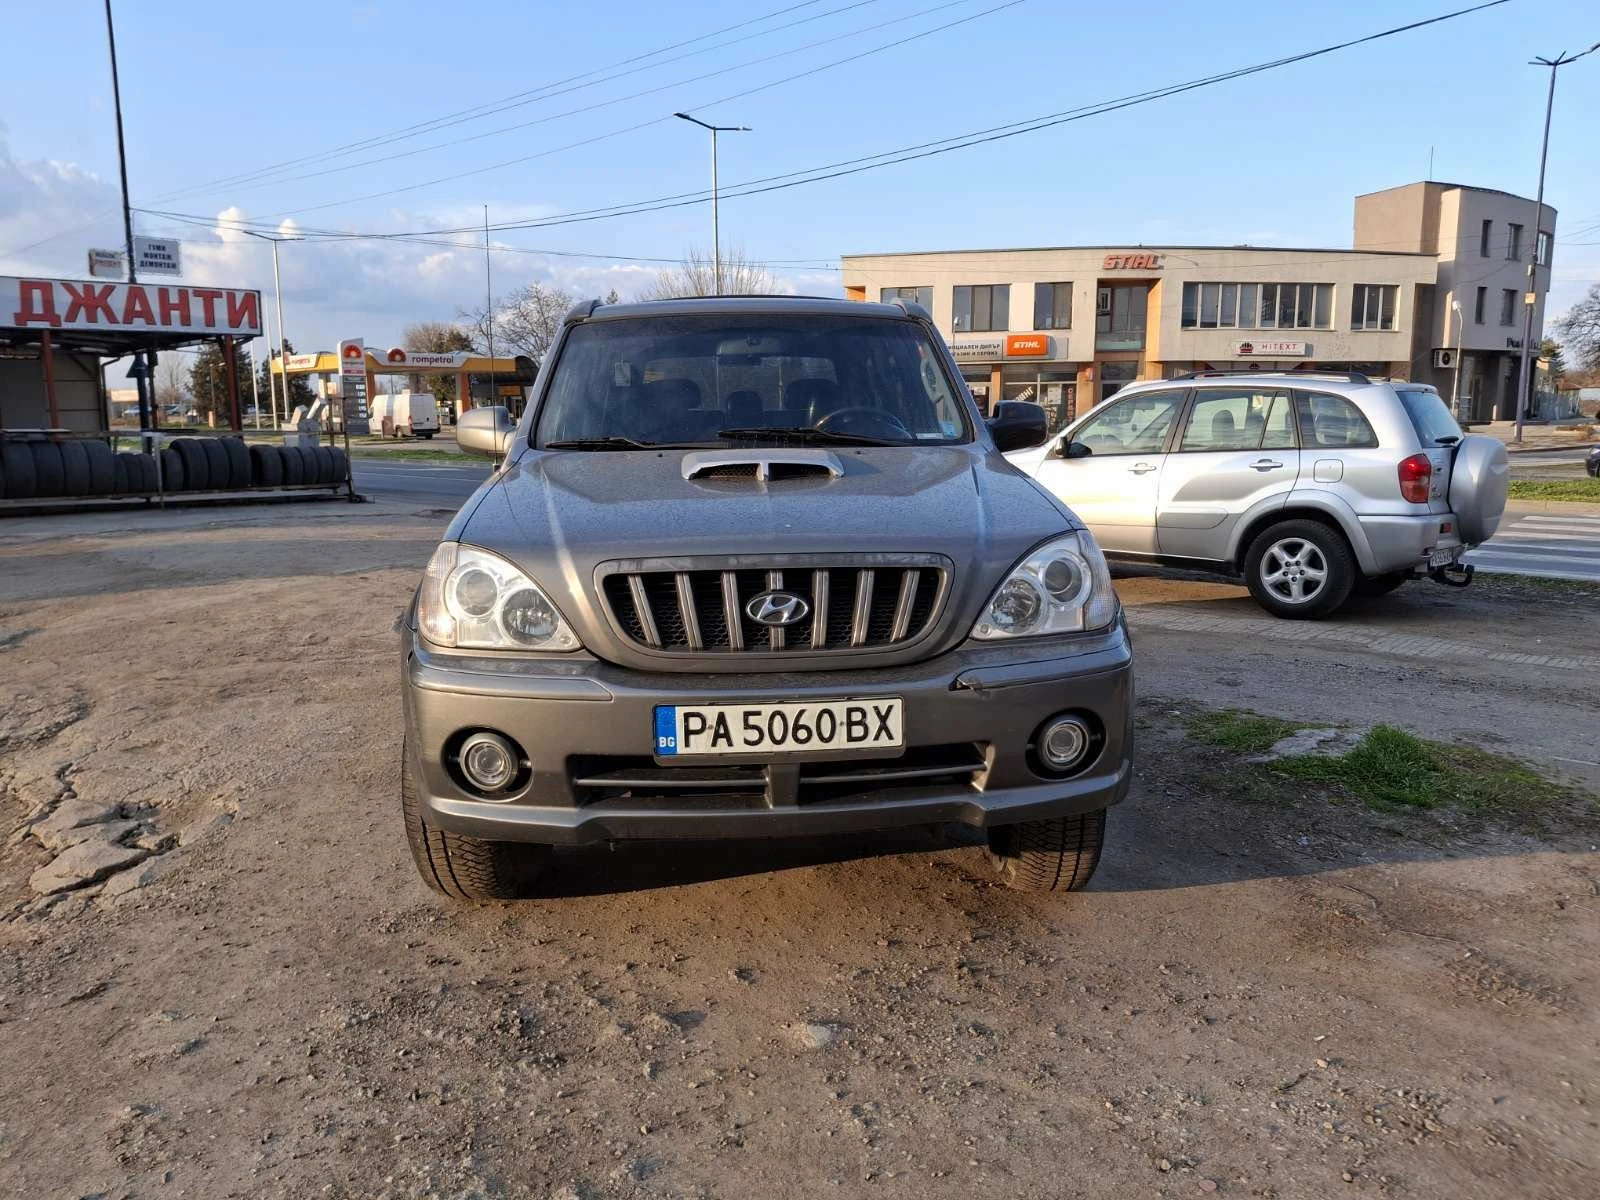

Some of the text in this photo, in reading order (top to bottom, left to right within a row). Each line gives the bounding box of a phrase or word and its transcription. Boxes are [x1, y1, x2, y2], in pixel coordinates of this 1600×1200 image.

[1103, 255, 1165, 270] STIHL
[14, 279, 258, 329] ДЖАНТИ
[1013, 341, 1041, 349] STIHL
[1262, 343, 1297, 351] HITEXT
[412, 356, 454, 365] rompetrol
[743, 708, 836, 747] 5060
[659, 736, 675, 748] BG
